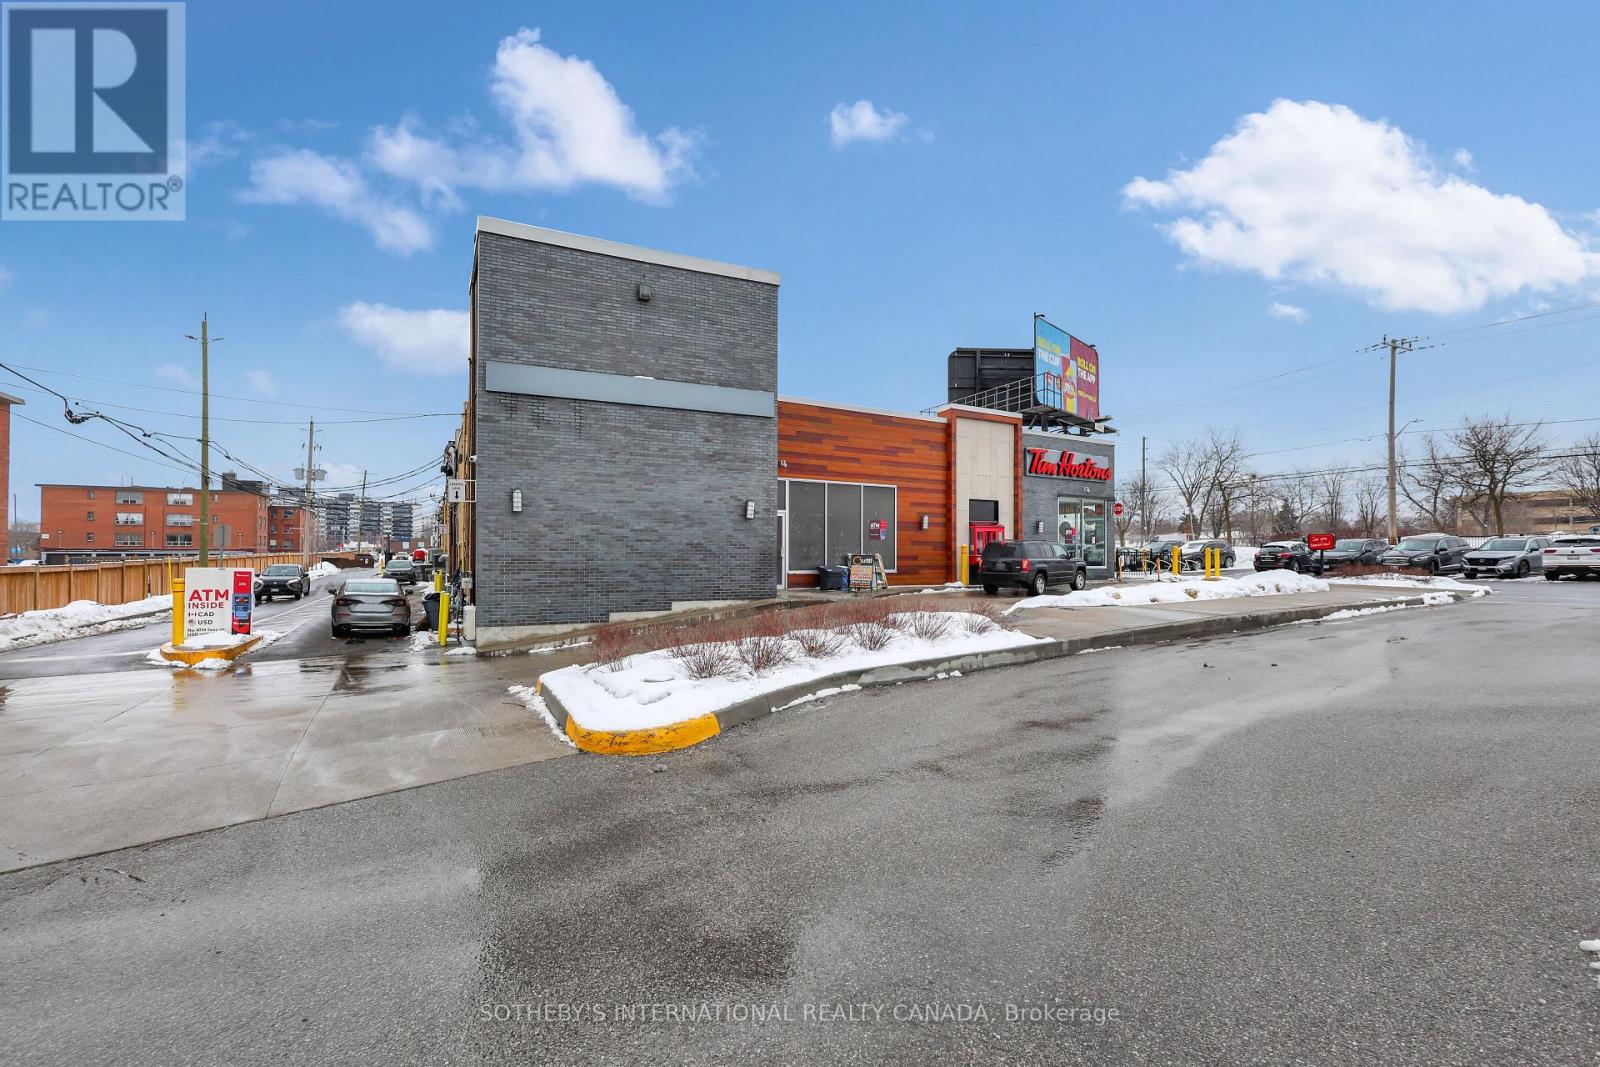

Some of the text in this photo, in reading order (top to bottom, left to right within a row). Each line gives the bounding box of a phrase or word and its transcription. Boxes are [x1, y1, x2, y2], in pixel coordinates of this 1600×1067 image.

[1028, 448, 1112, 480] Tim Hortons
[189, 589, 229, 601] ATM
